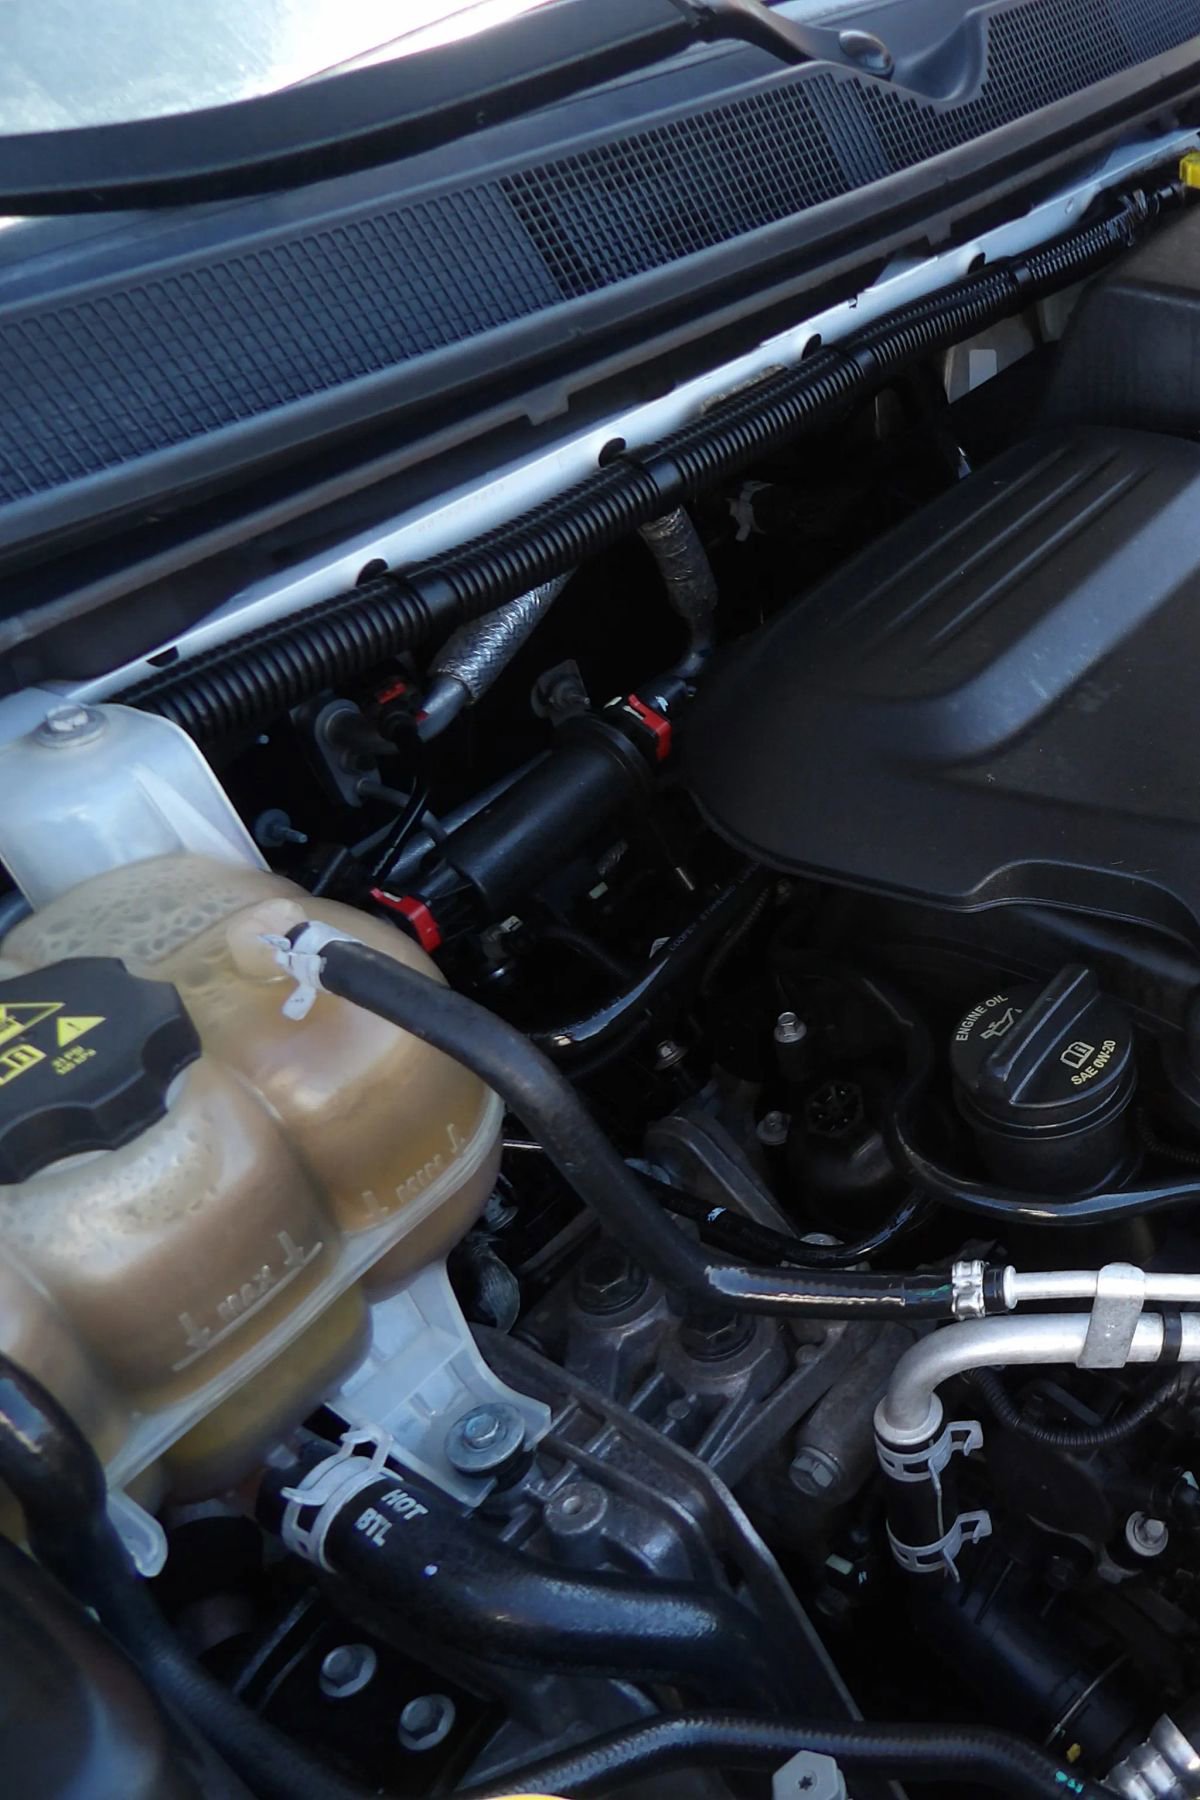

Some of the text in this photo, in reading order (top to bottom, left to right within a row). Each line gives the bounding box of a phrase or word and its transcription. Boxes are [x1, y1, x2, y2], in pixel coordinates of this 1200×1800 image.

[955, 994, 1009, 1041] ENGINE OIL
[1071, 1067, 1098, 1085] SAE
[381, 1488, 429, 1520] HOT
[354, 1507, 393, 1547] BTL
